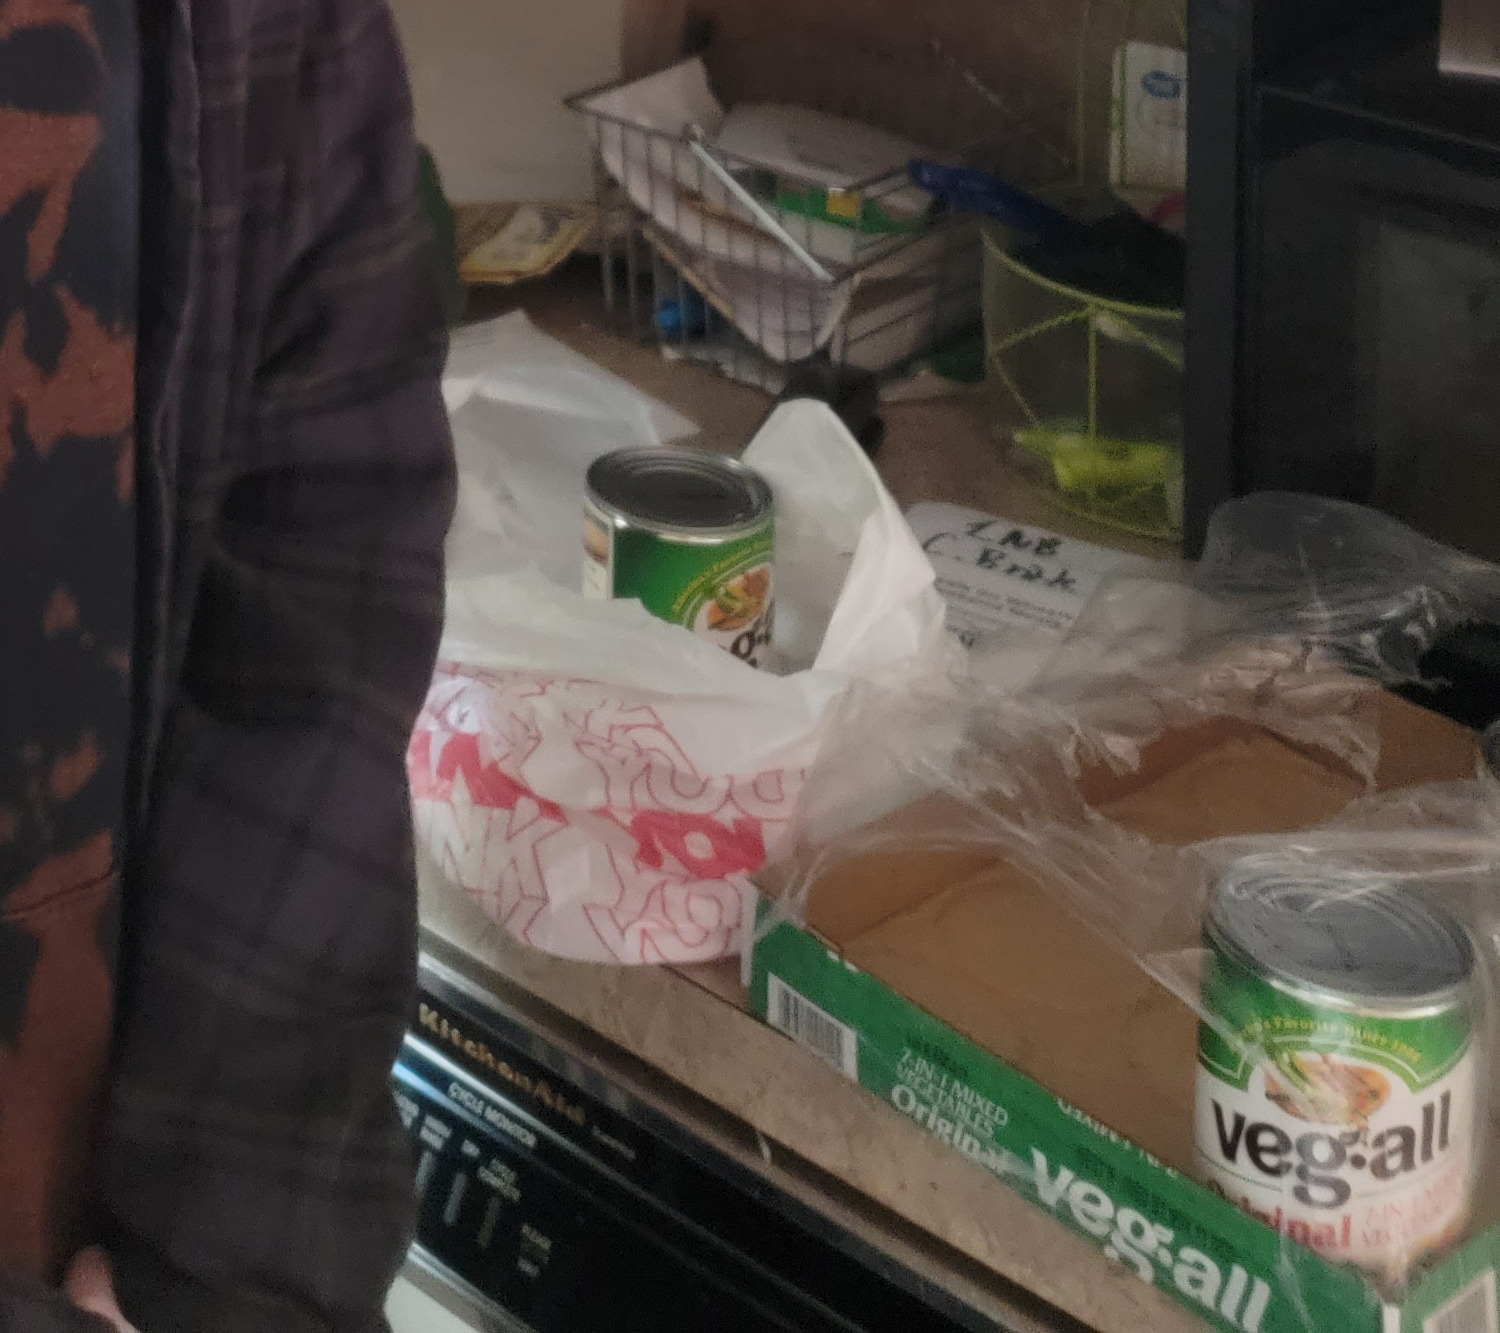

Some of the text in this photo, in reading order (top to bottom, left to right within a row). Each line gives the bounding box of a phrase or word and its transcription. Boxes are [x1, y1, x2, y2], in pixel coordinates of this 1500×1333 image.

[418, 1001, 587, 1127] KitchenAid
[951, 1079, 1009, 1127] MIXED
[891, 1083, 1004, 1174] Origin
